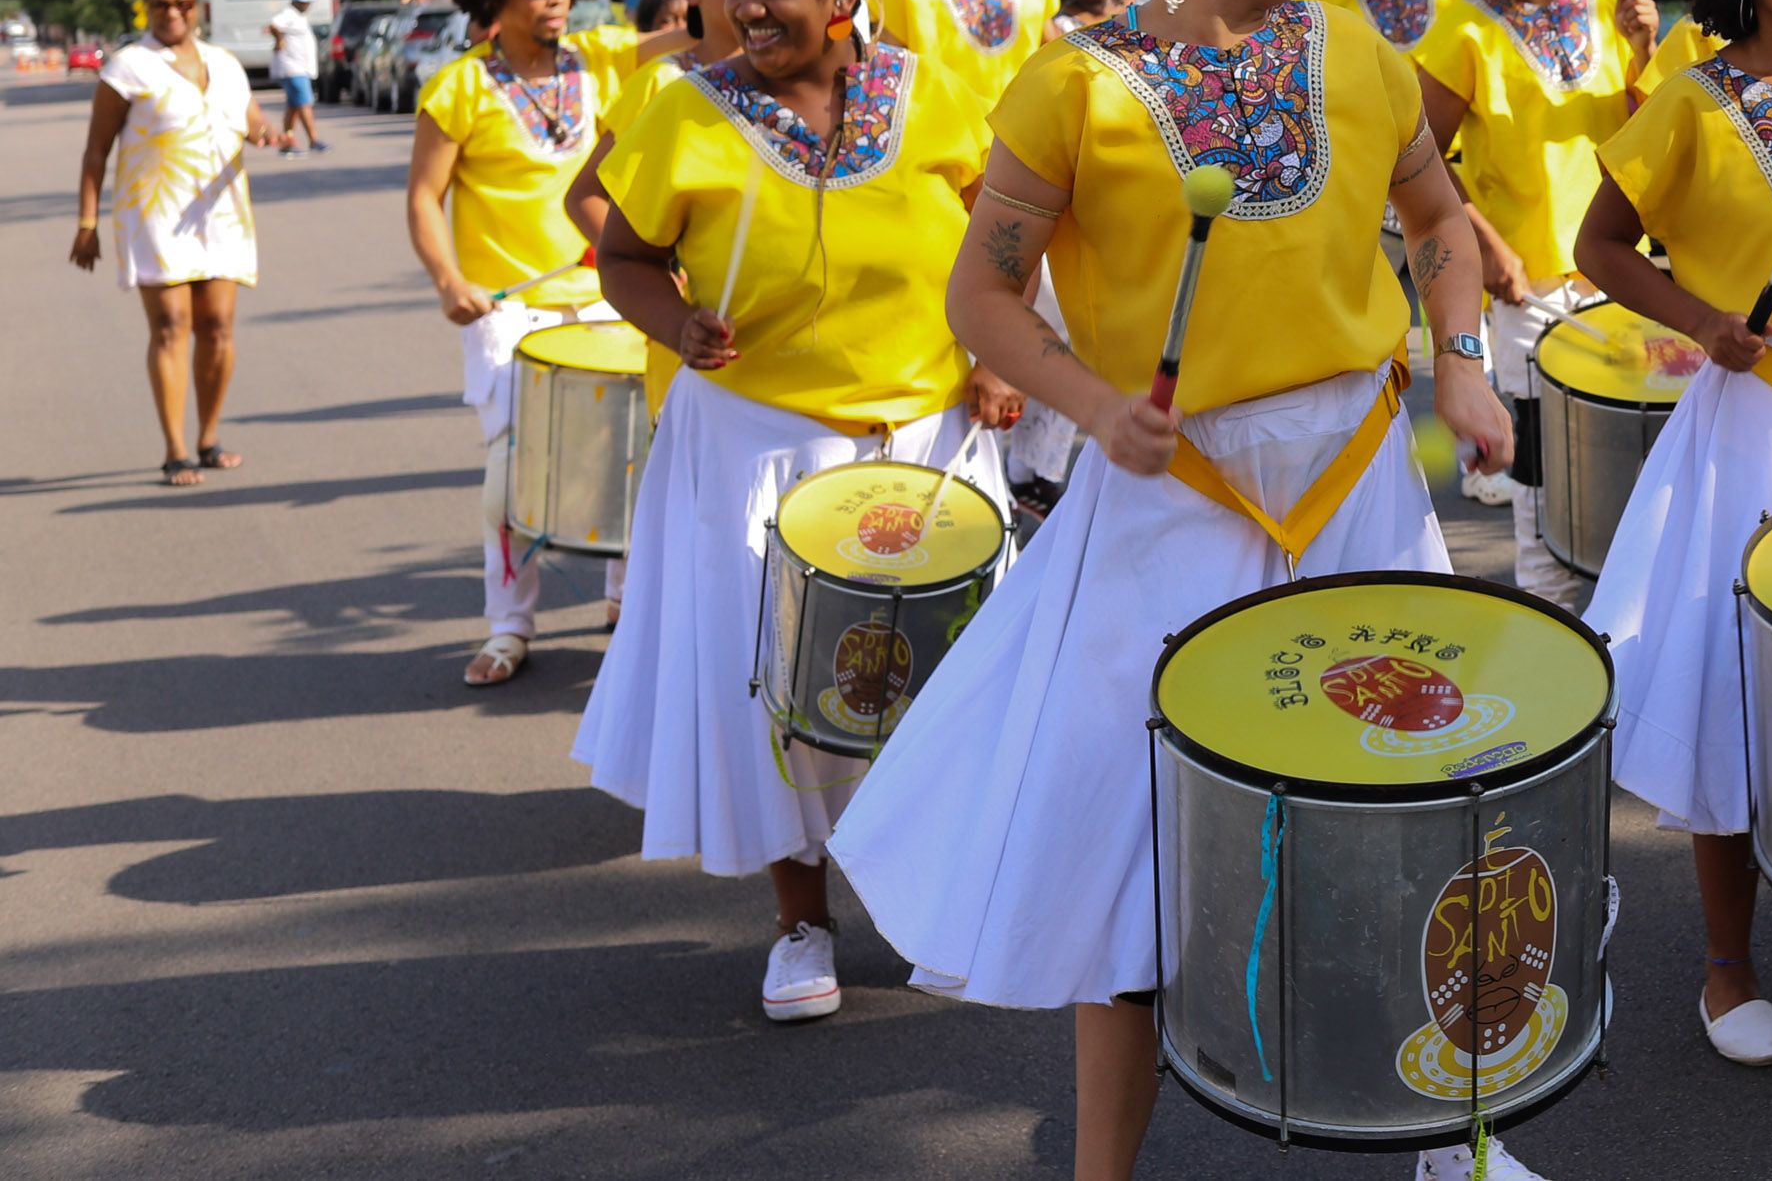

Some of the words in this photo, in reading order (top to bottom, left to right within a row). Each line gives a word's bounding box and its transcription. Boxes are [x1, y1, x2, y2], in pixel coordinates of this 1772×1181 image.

[1265, 633, 1326, 711] BLOCO
[1348, 625, 1466, 661] AFRO
[1484, 810, 1512, 870] É
[1428, 867, 1552, 969] SANTO
